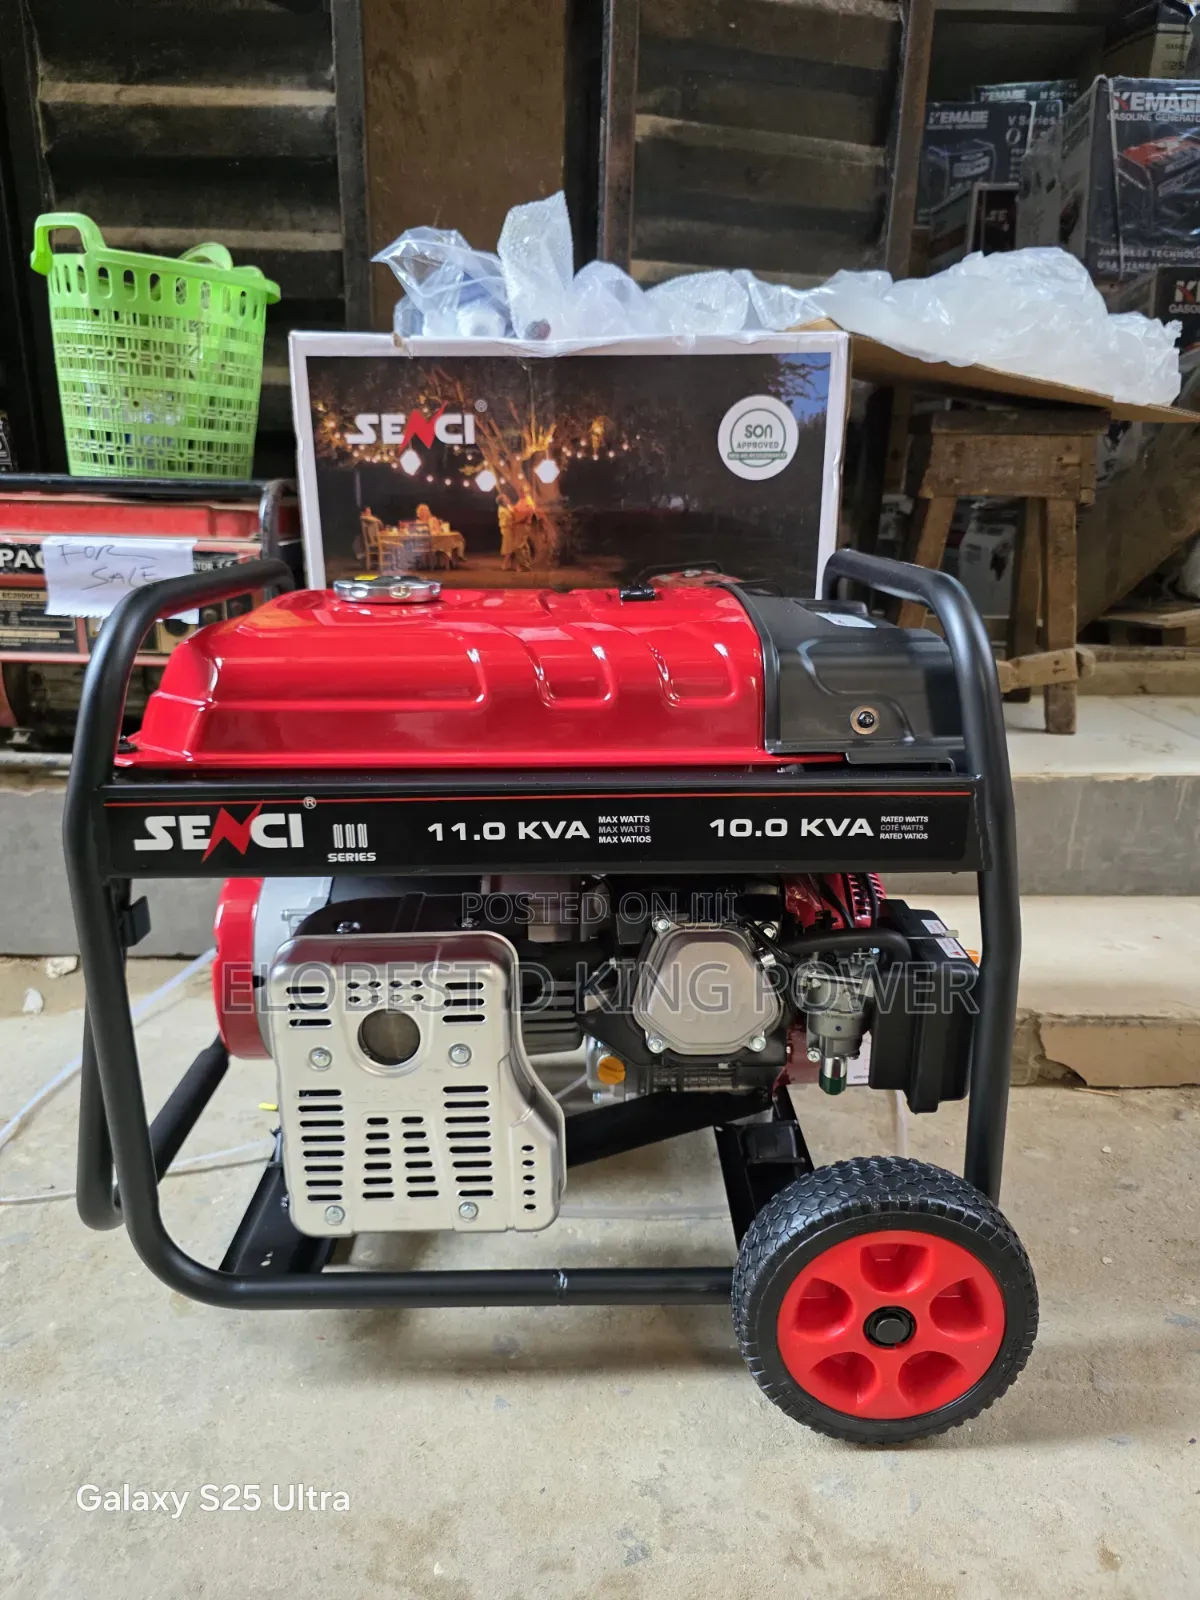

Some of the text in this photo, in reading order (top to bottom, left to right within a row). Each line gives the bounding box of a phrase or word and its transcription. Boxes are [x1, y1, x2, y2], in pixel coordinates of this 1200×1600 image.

[1098, 247, 1149, 257] JAPNESE
[1174, 280, 1200, 303] K
[344, 401, 477, 450] SENCI
[736, 441, 780, 449] APPROVED
[57, 543, 160, 565] FOR
[81, 565, 161, 591] SALE
[598, 815, 651, 823] MAX WATTS
[880, 815, 929, 823] RATED WATTS
[133, 801, 304, 863] SENCI
[427, 820, 591, 841] 11.0 KVA
[598, 825, 651, 833] MAX WATTS
[709, 818, 874, 838] 10.0 KVA
[598, 835, 652, 844] MAX VATIOS
[879, 832, 929, 840] RATED VATIOS
[327, 852, 377, 862] SERIES
